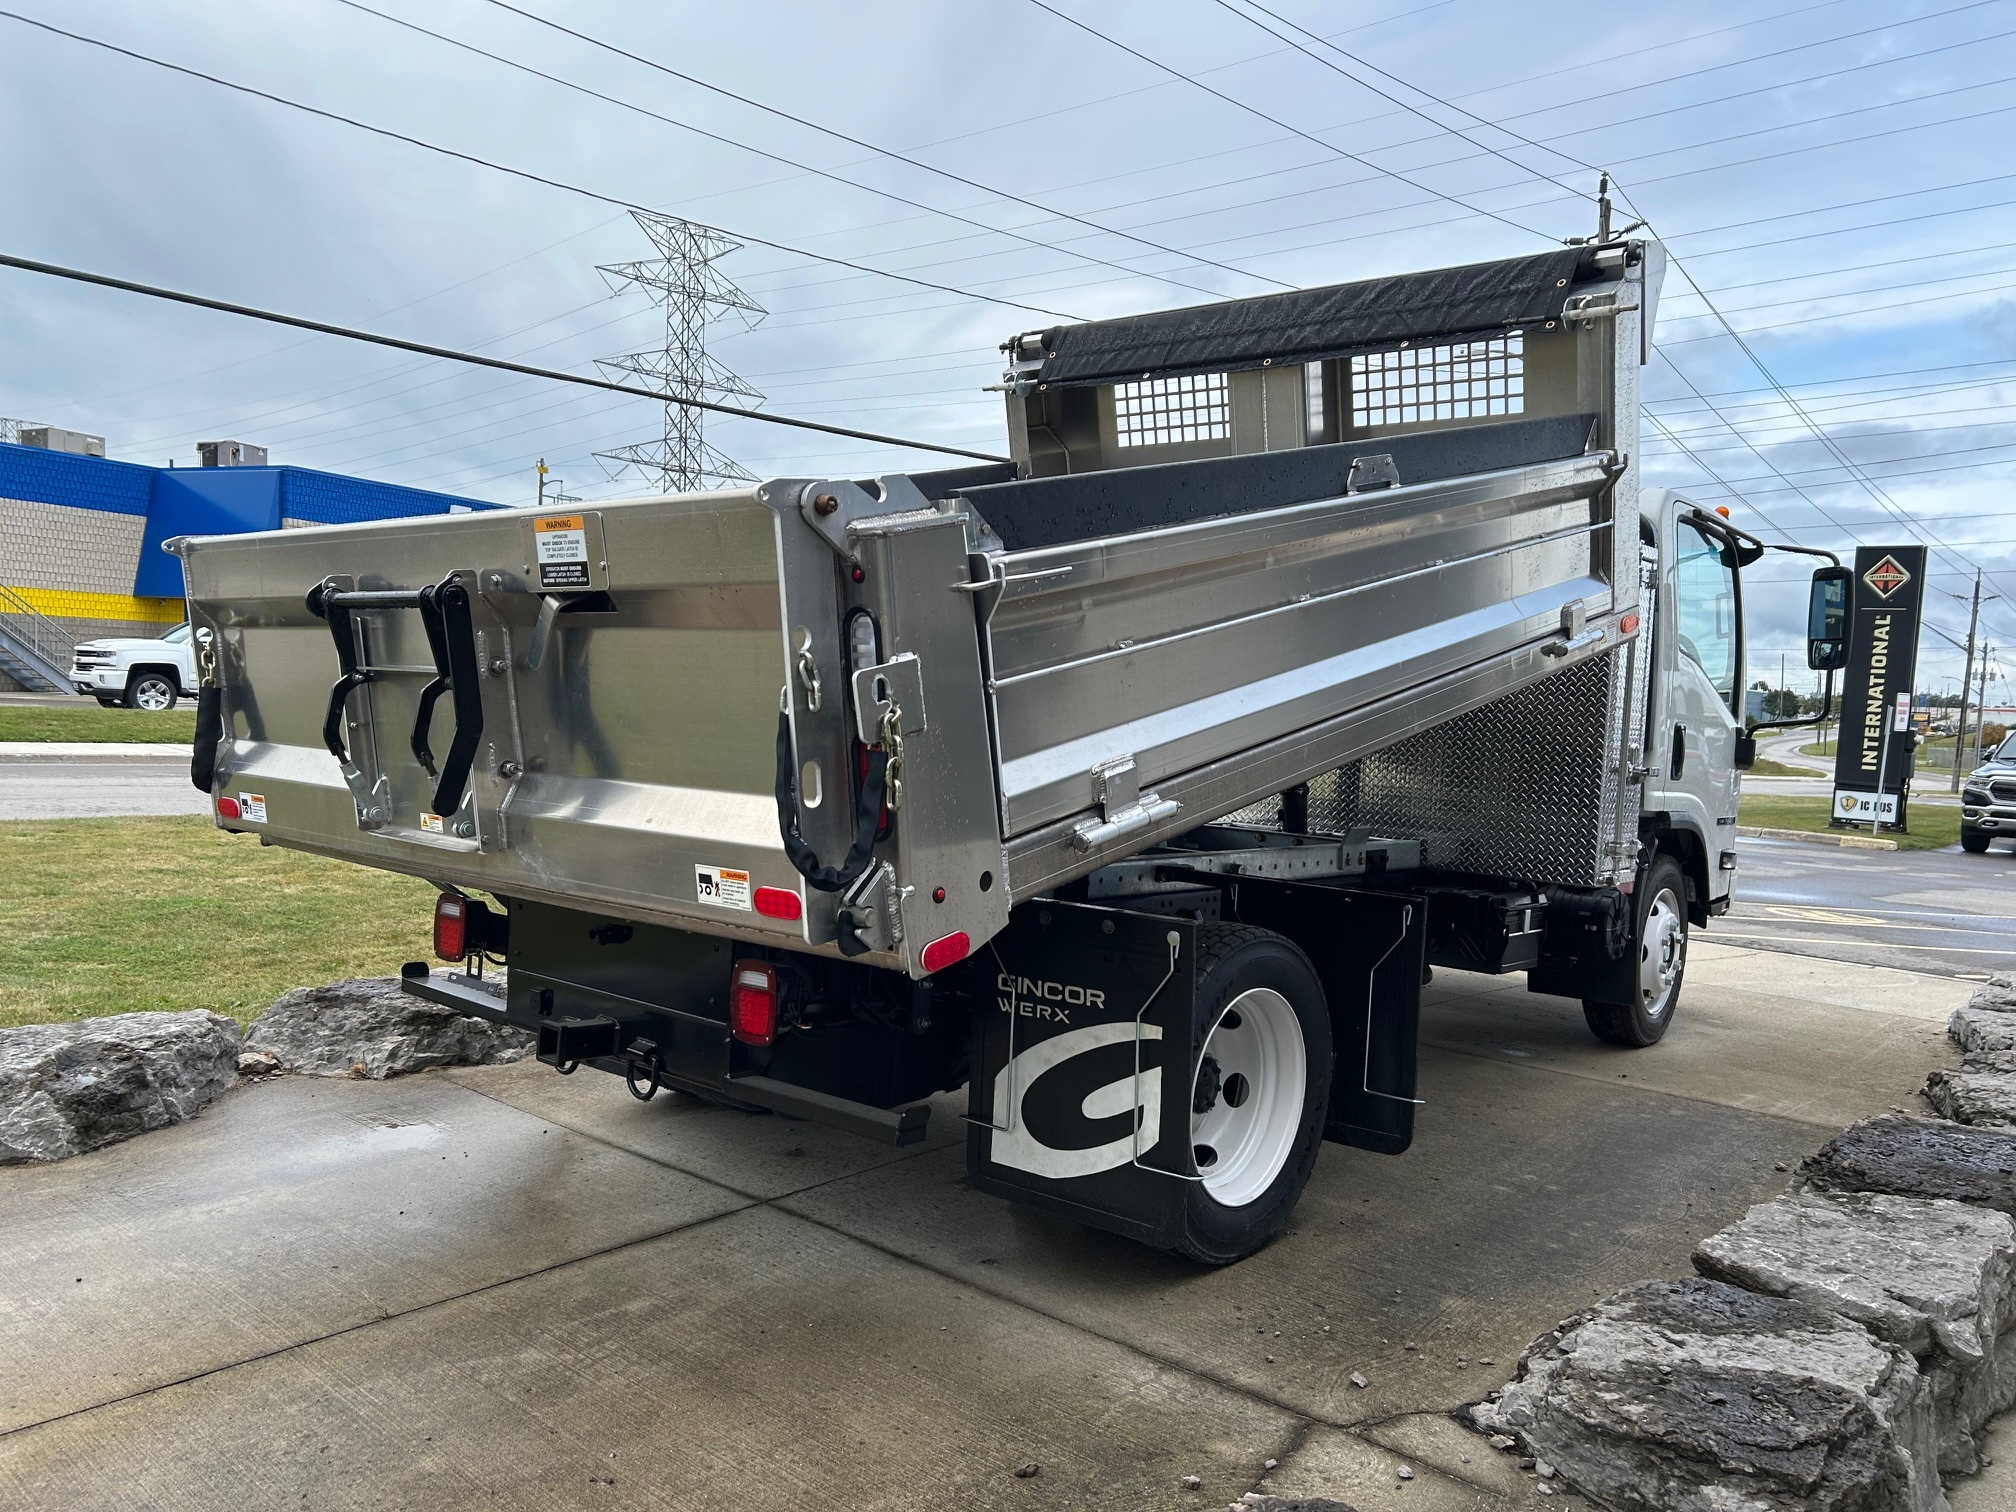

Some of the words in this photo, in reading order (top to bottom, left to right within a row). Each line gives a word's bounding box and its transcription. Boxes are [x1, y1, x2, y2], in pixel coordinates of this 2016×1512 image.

[545, 520, 571, 529] WARNING
[1861, 614, 1891, 771] INTERNATIONAL
[1860, 801, 1870, 811] IC
[997, 973, 1105, 1009] GINCOR
[997, 996, 1070, 1024] WERX
